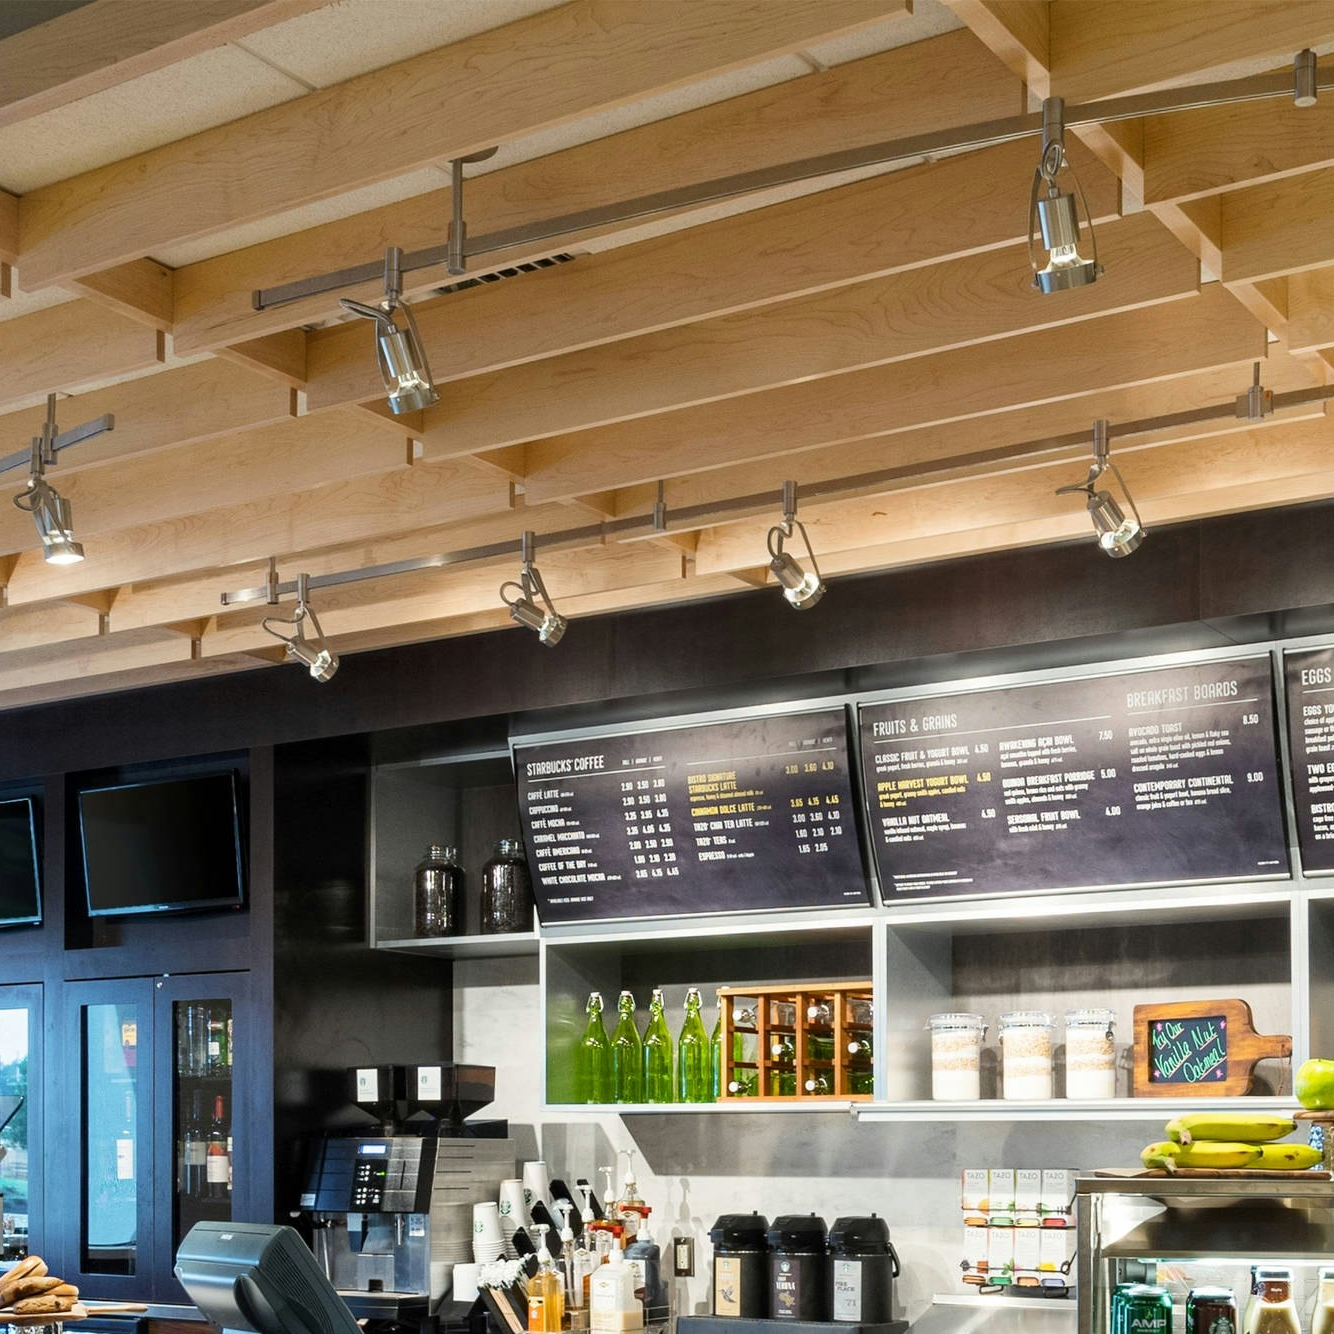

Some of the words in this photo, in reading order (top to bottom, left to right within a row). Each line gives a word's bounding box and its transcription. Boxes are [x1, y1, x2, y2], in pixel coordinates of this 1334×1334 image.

[1301, 666, 1332, 685] EGGS
[1126, 686, 1188, 708] BREAKFAST
[1192, 680, 1237, 701] BOARDS
[1302, 704, 1322, 716] EGGS
[873, 719, 906, 736] FRUITS
[909, 718, 919, 732] &
[922, 713, 957, 731] GRAINS
[1128, 724, 1159, 737] AVOCADO
[1160, 722, 1182, 733] TOAST
[1054, 734, 1074, 745] BOWL
[574, 754, 604, 771] COFFEE
[874, 752, 900, 764] CLASSIC
[900, 750, 918, 761] FRUIT
[926, 747, 950, 758] YOGURT
[951, 745, 970, 756] BOWL
[1306, 763, 1325, 774] TWO
[949, 774, 969, 785] BOWL
[1133, 779, 1185, 793] CONTEMPORARY
[1187, 774, 1234, 788] CONTINENTAL
[737, 802, 755, 813] LATTE
[1152, 1029, 1172, 1049] Try
[1165, 1022, 1182, 1039] Our
[1154, 1041, 1193, 1078] Vanilla
[1191, 1021, 1217, 1050] Nut
[1183, 1037, 1226, 1083] Oatmeal
[1131, 1319, 1167, 1329] AMP
